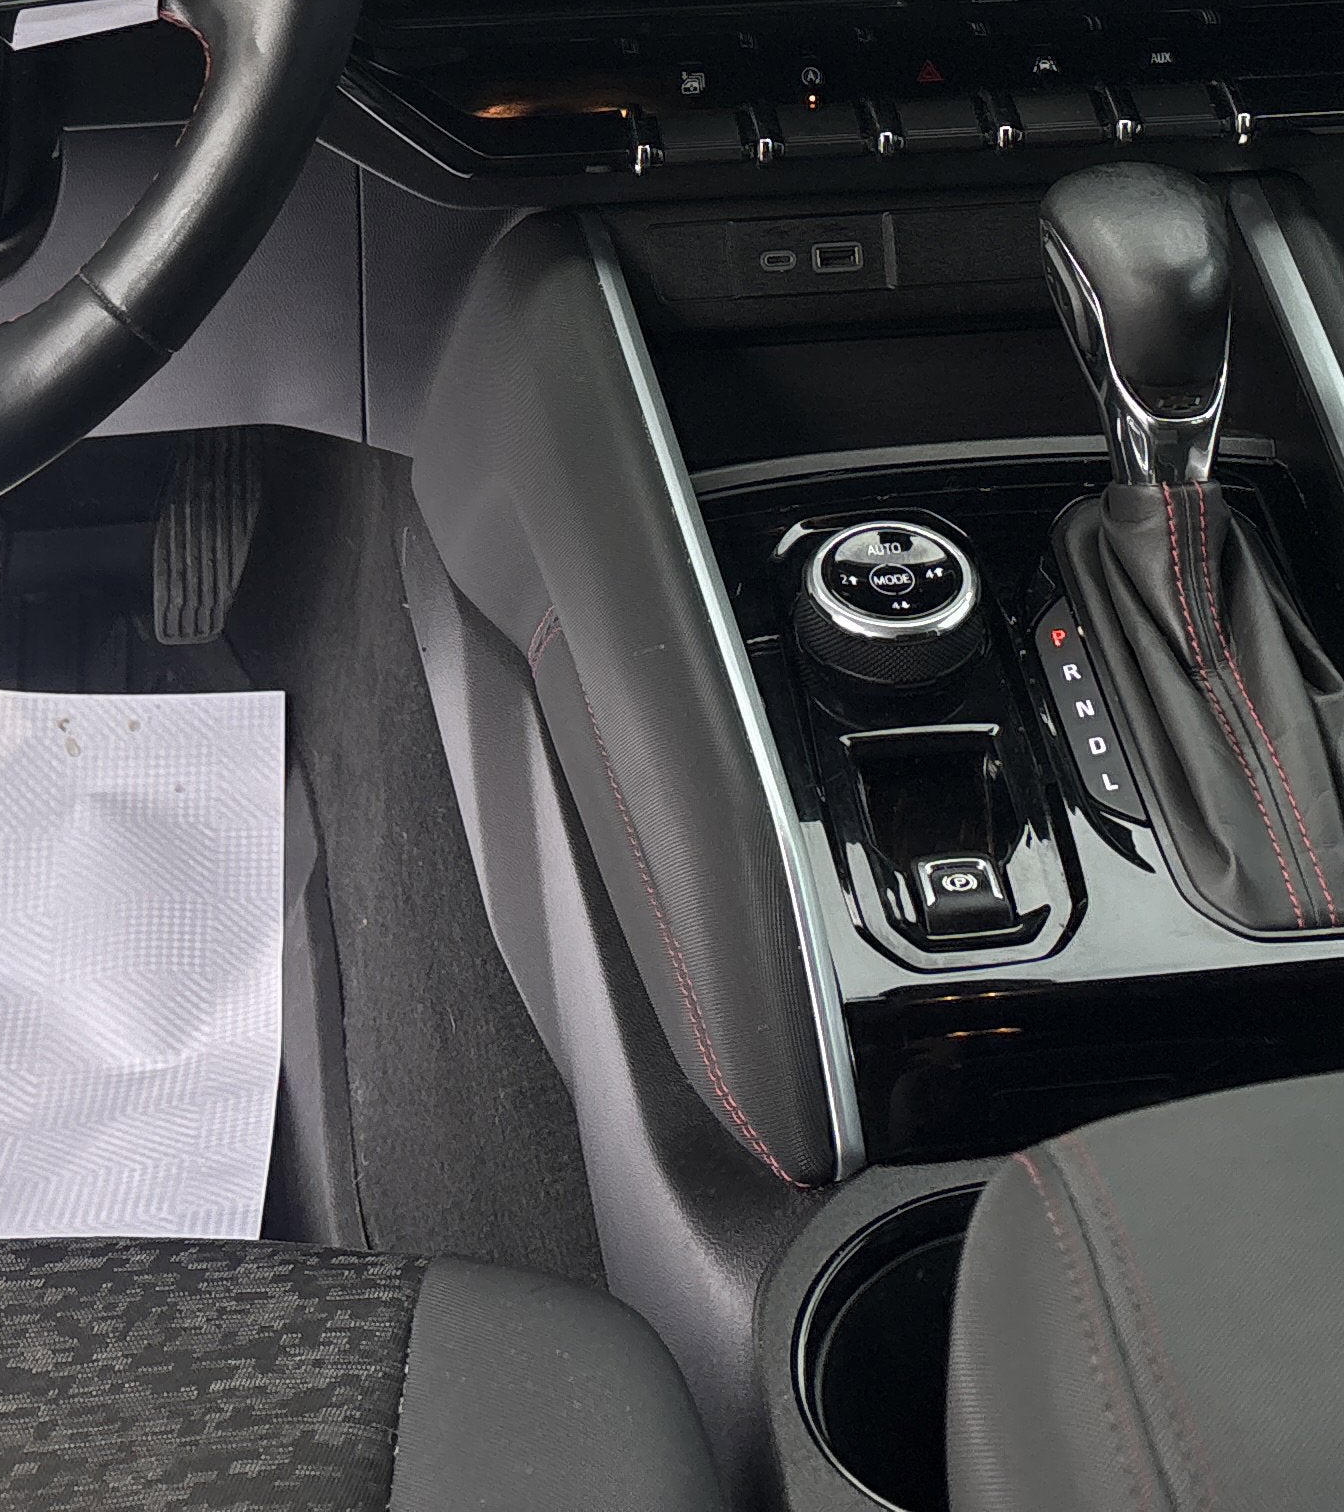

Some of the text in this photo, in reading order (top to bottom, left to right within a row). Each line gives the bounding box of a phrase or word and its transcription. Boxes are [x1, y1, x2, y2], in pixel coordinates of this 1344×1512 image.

[1150, 52, 1172, 64] AUX
[867, 542, 902, 557] AUTO
[873, 573, 912, 586] MODE
[1050, 628, 1066, 647] P
[1062, 663, 1082, 682] R
[1075, 699, 1095, 718] N
[1088, 736, 1107, 755] D
[1101, 773, 1119, 792] L
